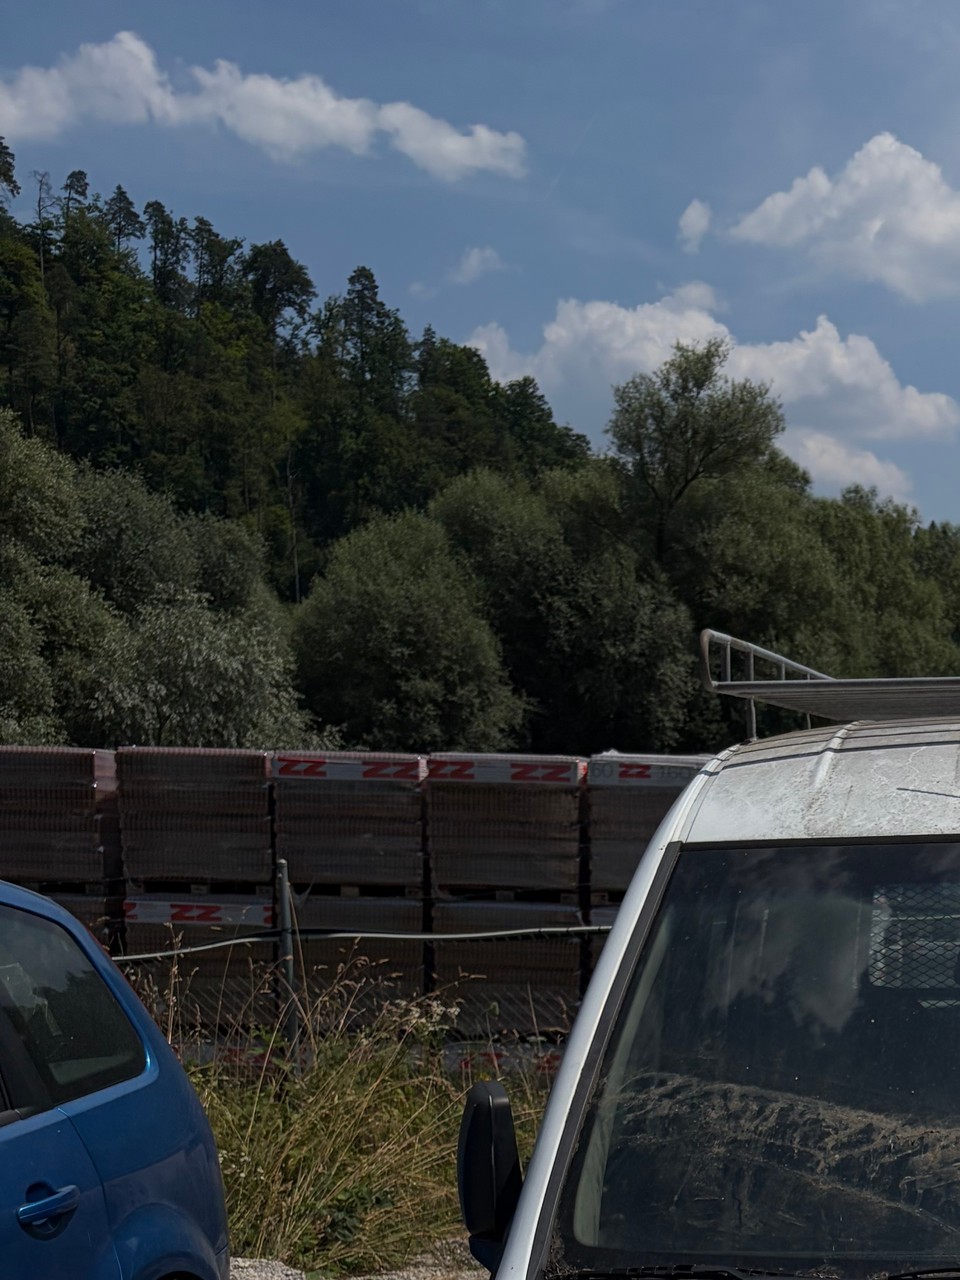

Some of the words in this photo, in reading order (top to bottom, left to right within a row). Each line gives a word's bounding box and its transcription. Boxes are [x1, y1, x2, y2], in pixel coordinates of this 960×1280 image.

[278, 758, 327, 777] ZZ
[362, 761, 419, 781] ZZ
[427, 760, 475, 780] ZZ
[510, 763, 571, 782] ZZ
[619, 763, 651, 778] ZZ
[170, 903, 222, 922] ZZ
